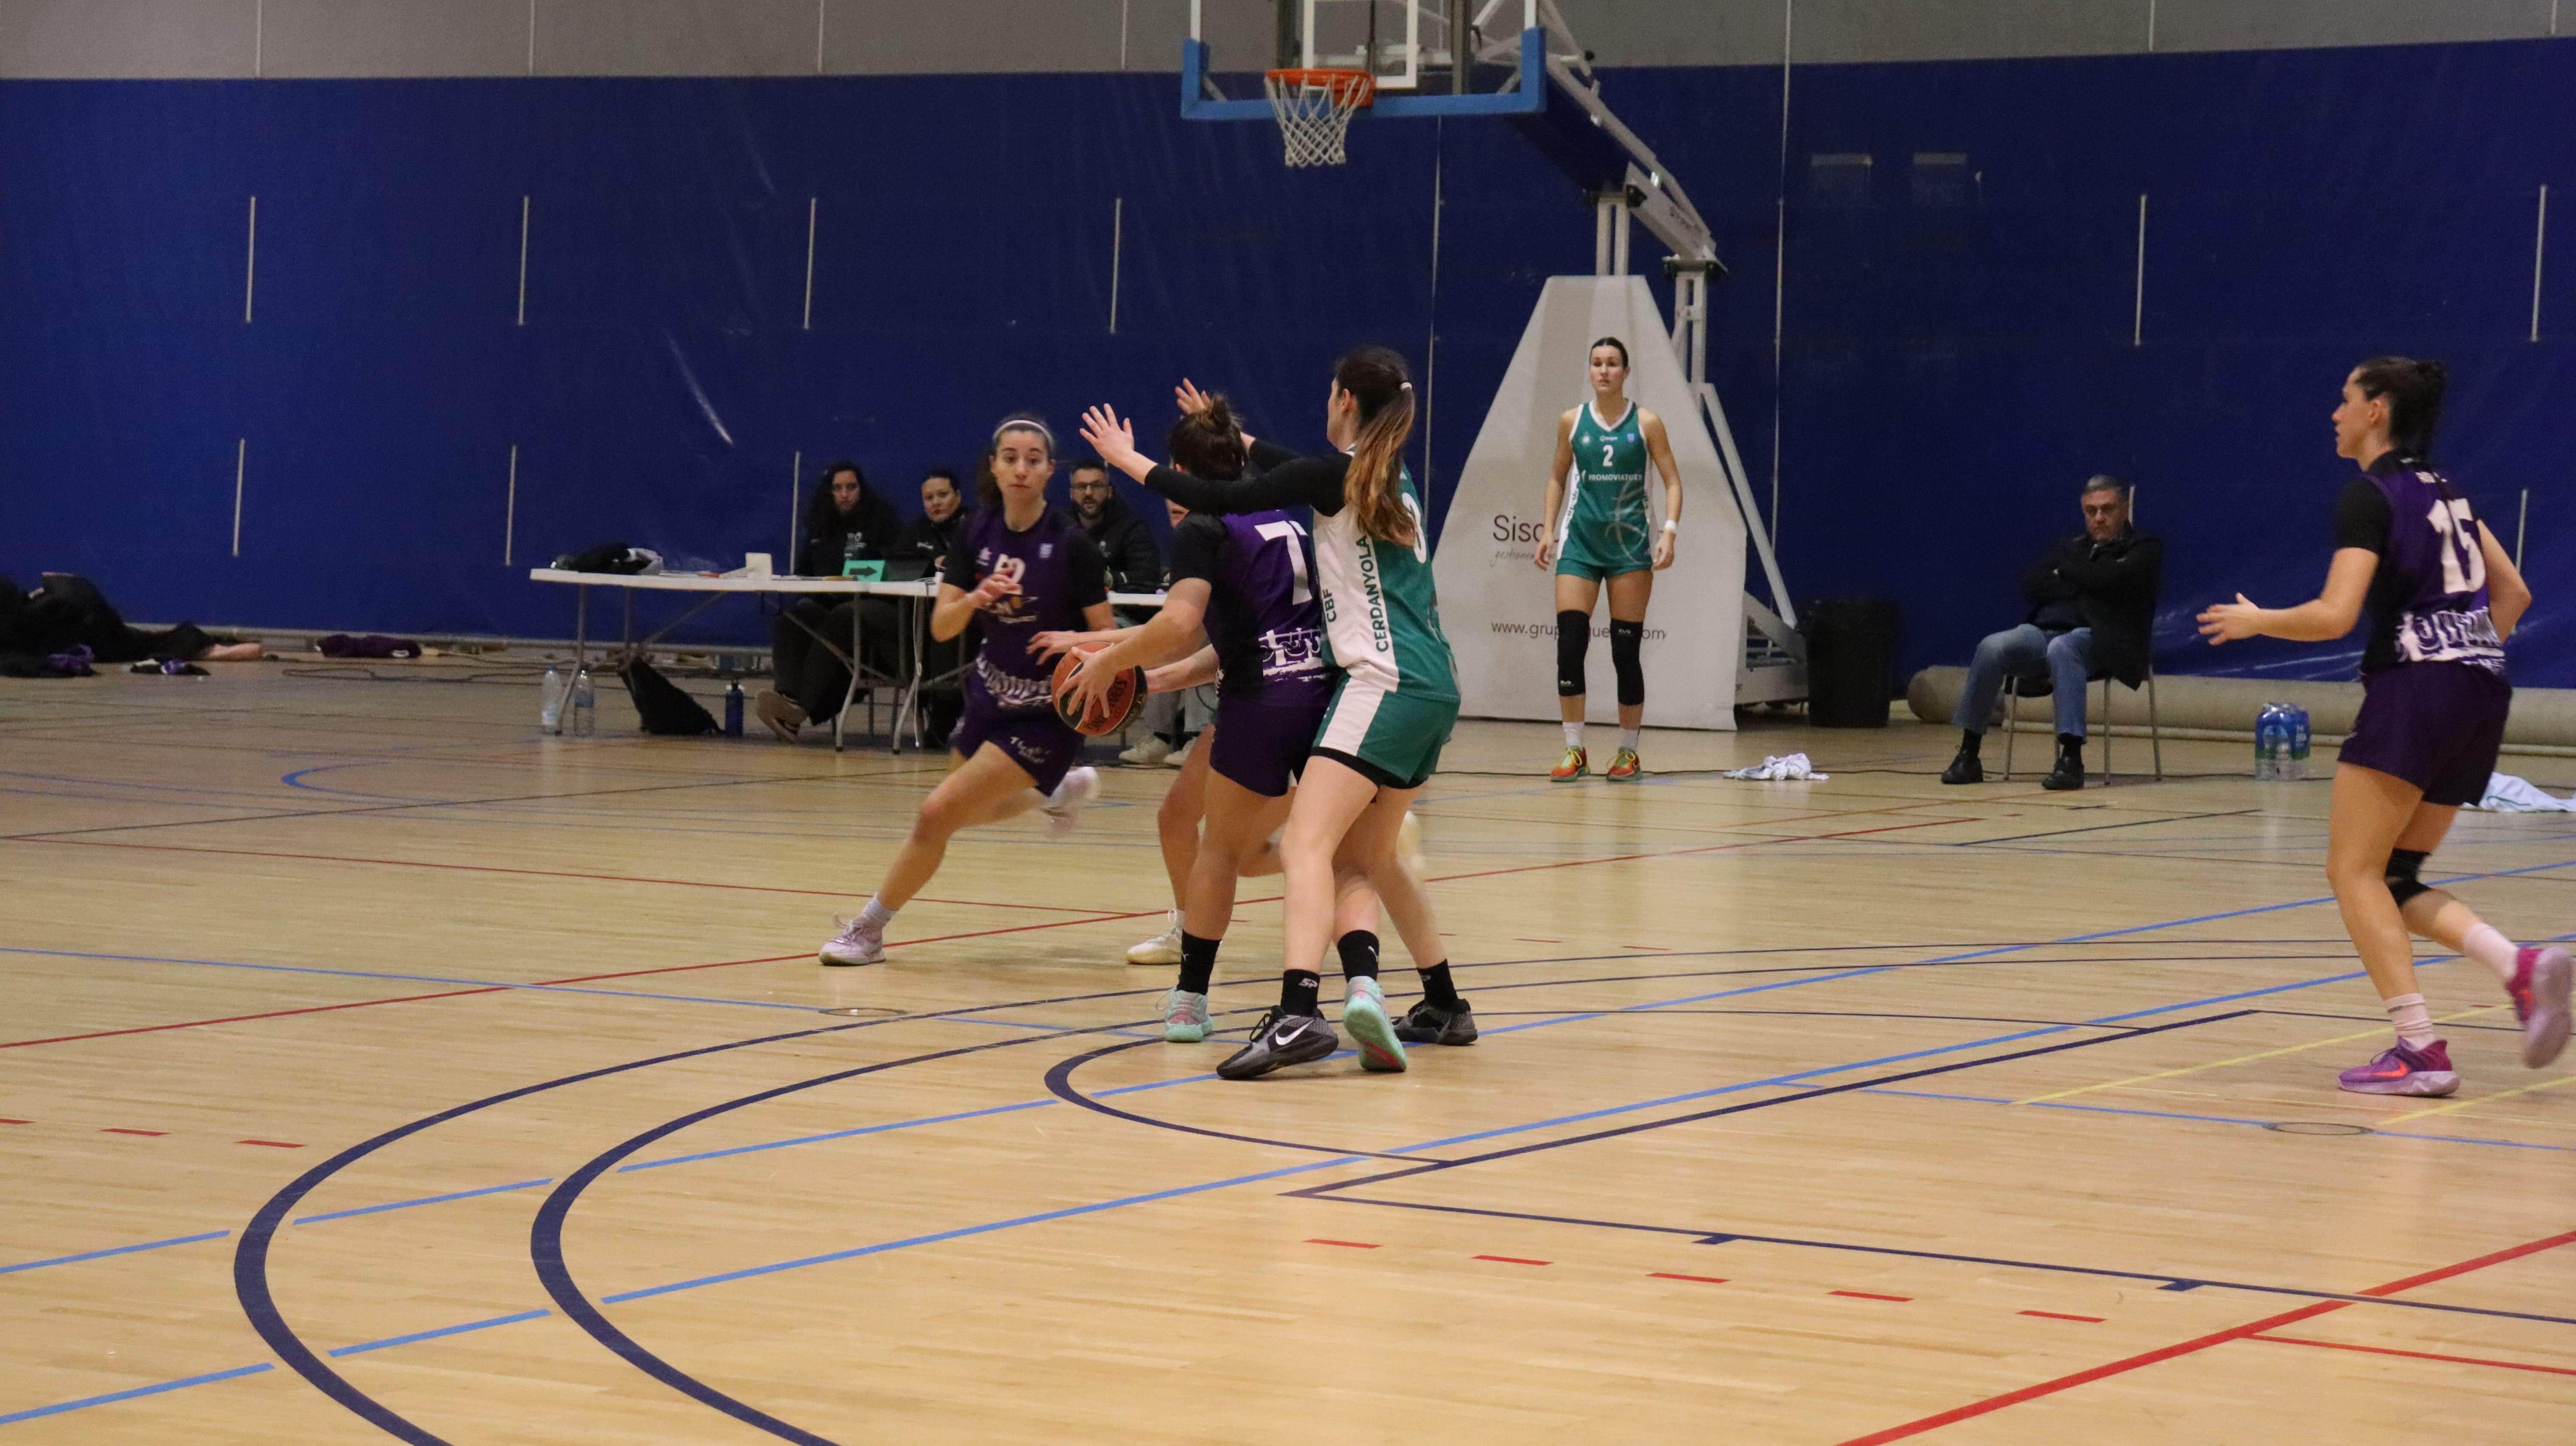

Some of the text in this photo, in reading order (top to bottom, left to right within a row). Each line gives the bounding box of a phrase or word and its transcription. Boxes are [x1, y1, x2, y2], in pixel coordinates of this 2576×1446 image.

[1602, 444, 1614, 467] 2
[2426, 498, 2486, 594] 15
[1322, 589, 1337, 623] CBF
[1356, 535, 1389, 652] CERDANYOLA
